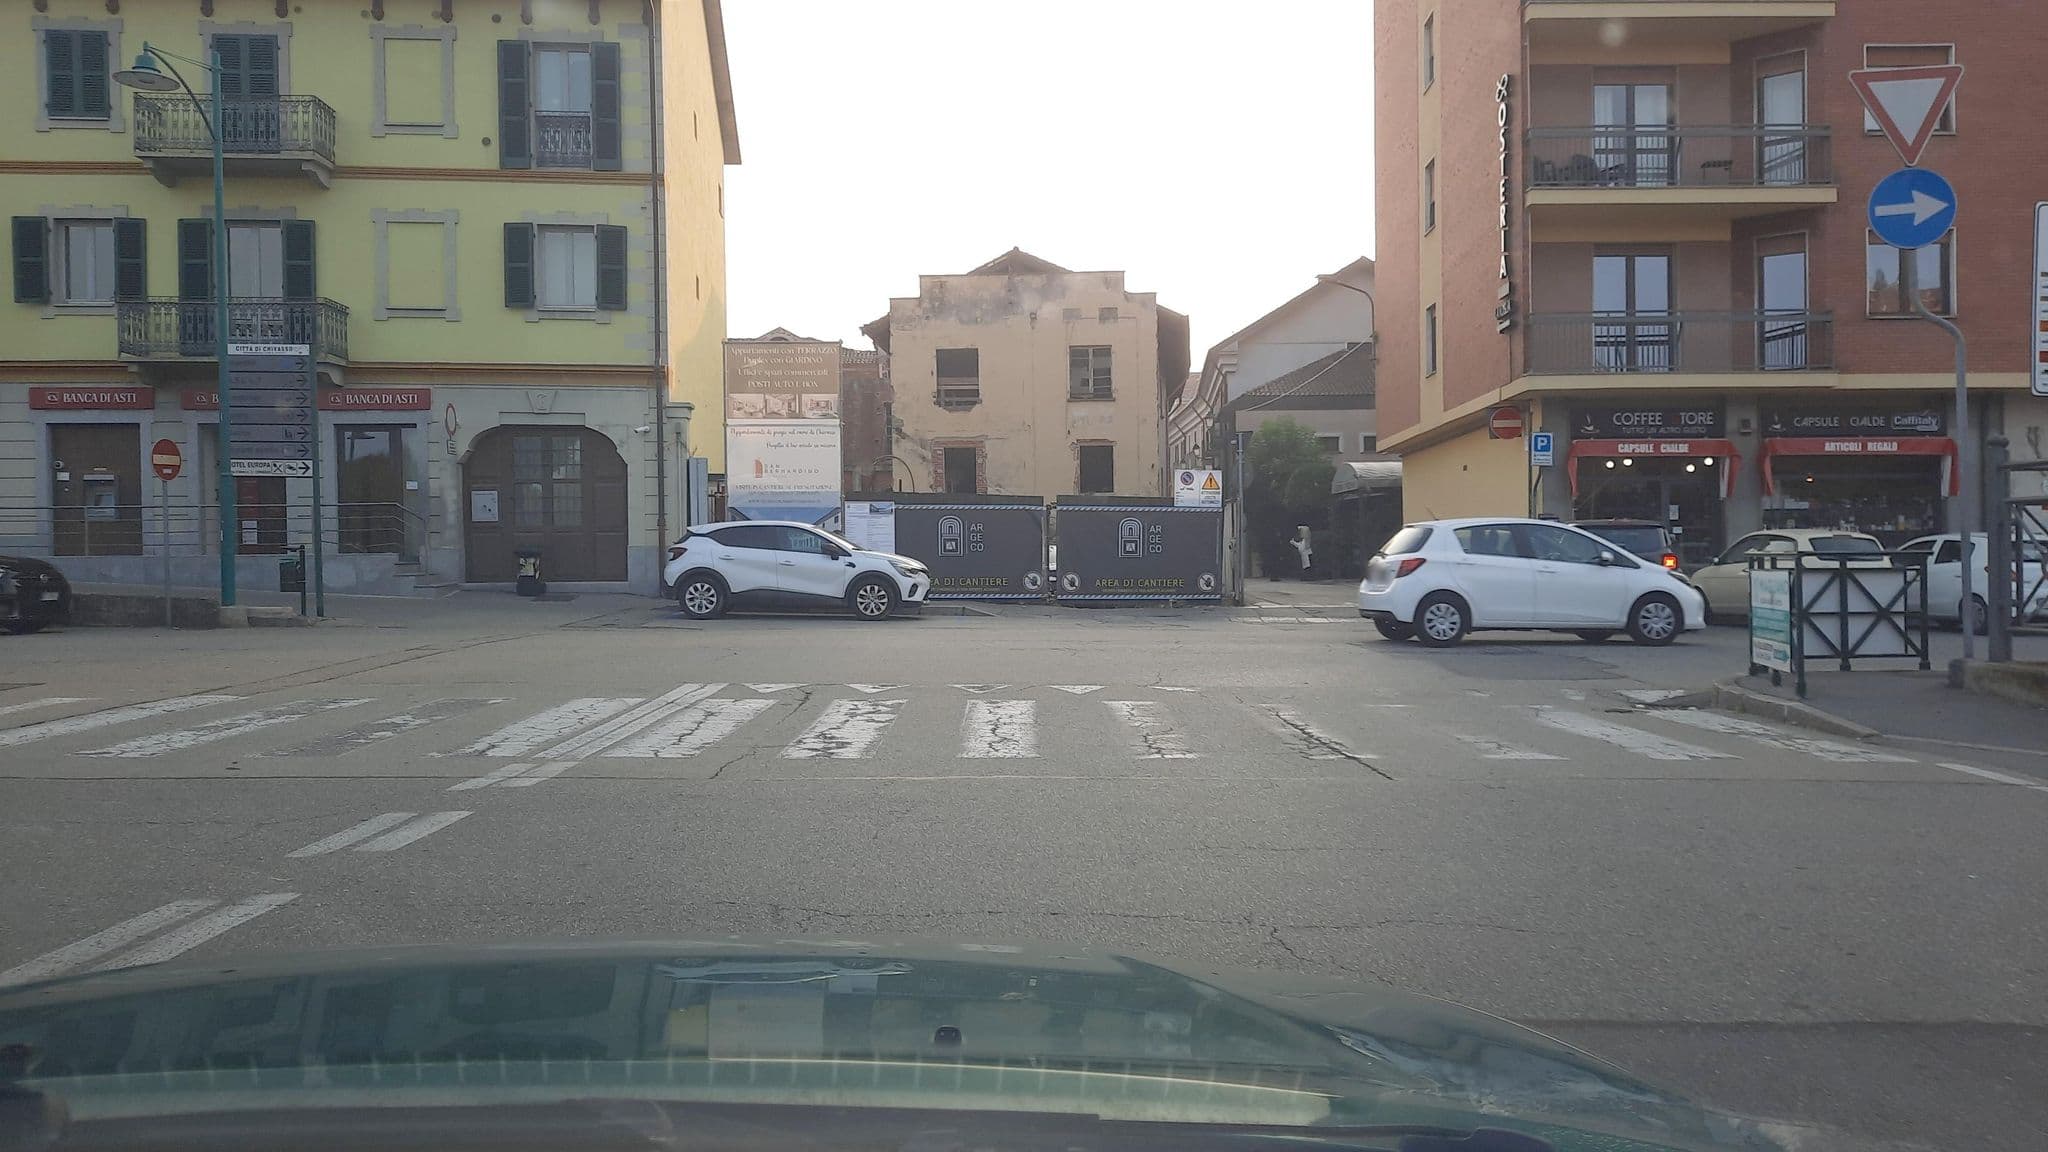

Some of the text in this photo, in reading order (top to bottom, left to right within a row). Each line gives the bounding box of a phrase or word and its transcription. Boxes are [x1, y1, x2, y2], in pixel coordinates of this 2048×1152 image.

[730, 347, 779, 356] Appartamenti
[63, 393, 136, 403] BANCA DI ASTI
[346, 394, 418, 404] BANCA DI ASTI
[1613, 412, 1663, 426] COFFEE
[1794, 416, 1840, 427] CAPSULE
[1618, 444, 1654, 453] CAPSULE
[1824, 442, 1898, 452] ARTICOLI REGALO
[970, 523, 984, 531] AR
[1150, 526, 1162, 534] AR
[970, 533, 983, 542] GE
[1150, 535, 1162, 544] GE
[970, 543, 984, 552] CO
[1150, 545, 1162, 553] CO
[944, 578, 955, 586] DI
[959, 578, 1008, 586] CANTIERE
[1096, 579, 1184, 587] AREA DI CANTIERE
